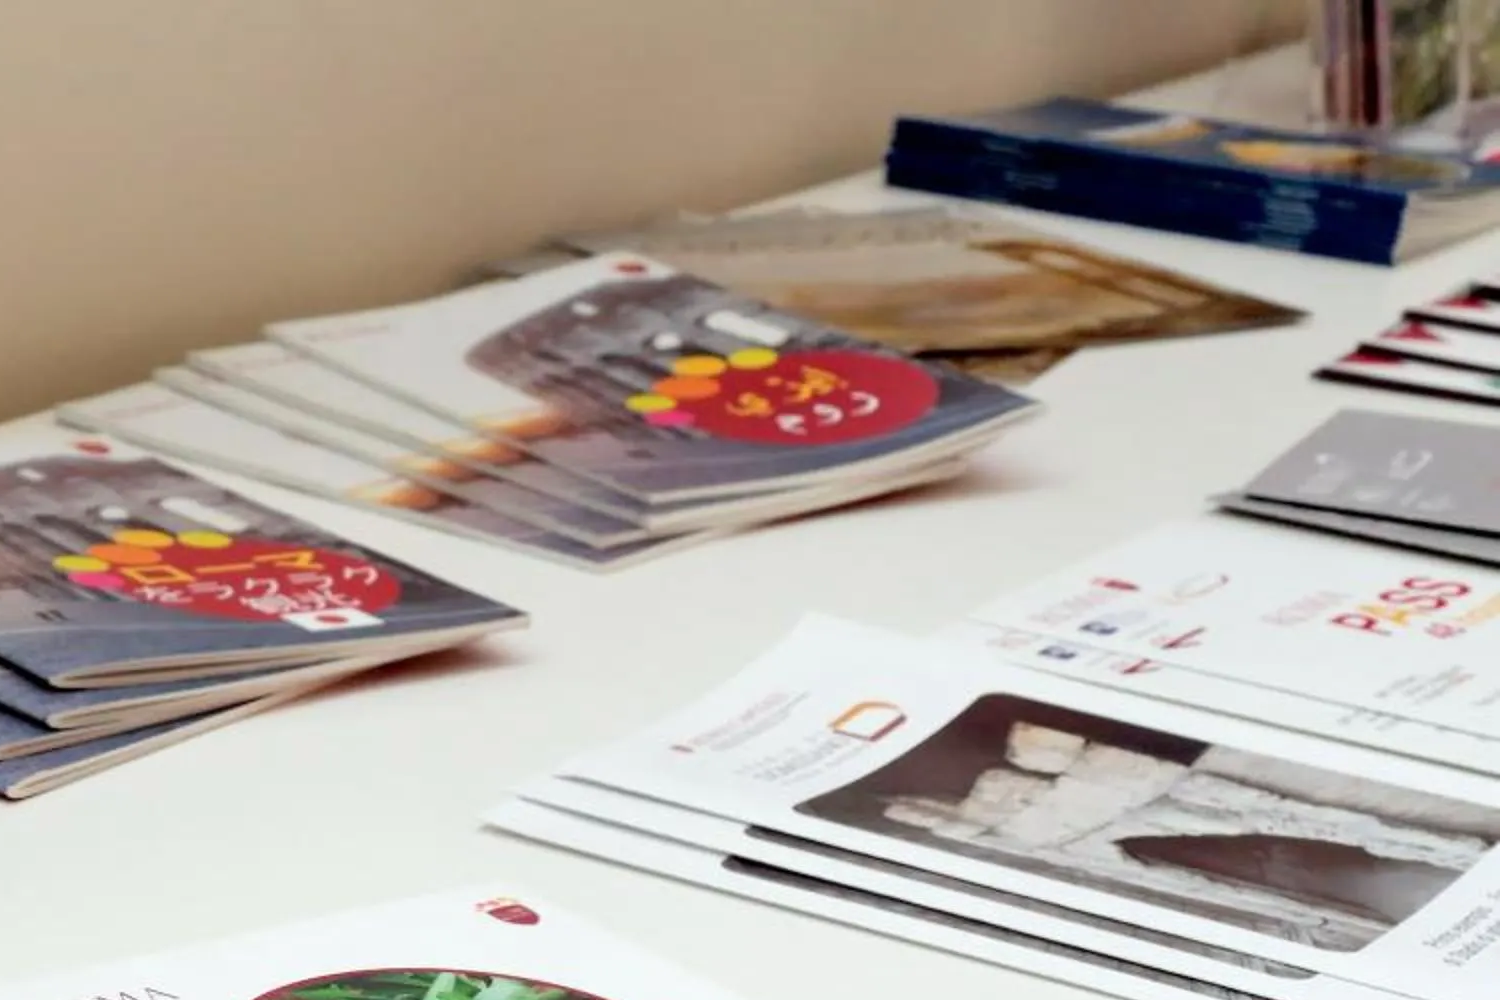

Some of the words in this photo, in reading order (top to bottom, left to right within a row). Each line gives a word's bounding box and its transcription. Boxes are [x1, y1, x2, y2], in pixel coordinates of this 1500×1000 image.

[119, 551, 325, 585] ローマ
[1329, 576, 1472, 637] PASS
